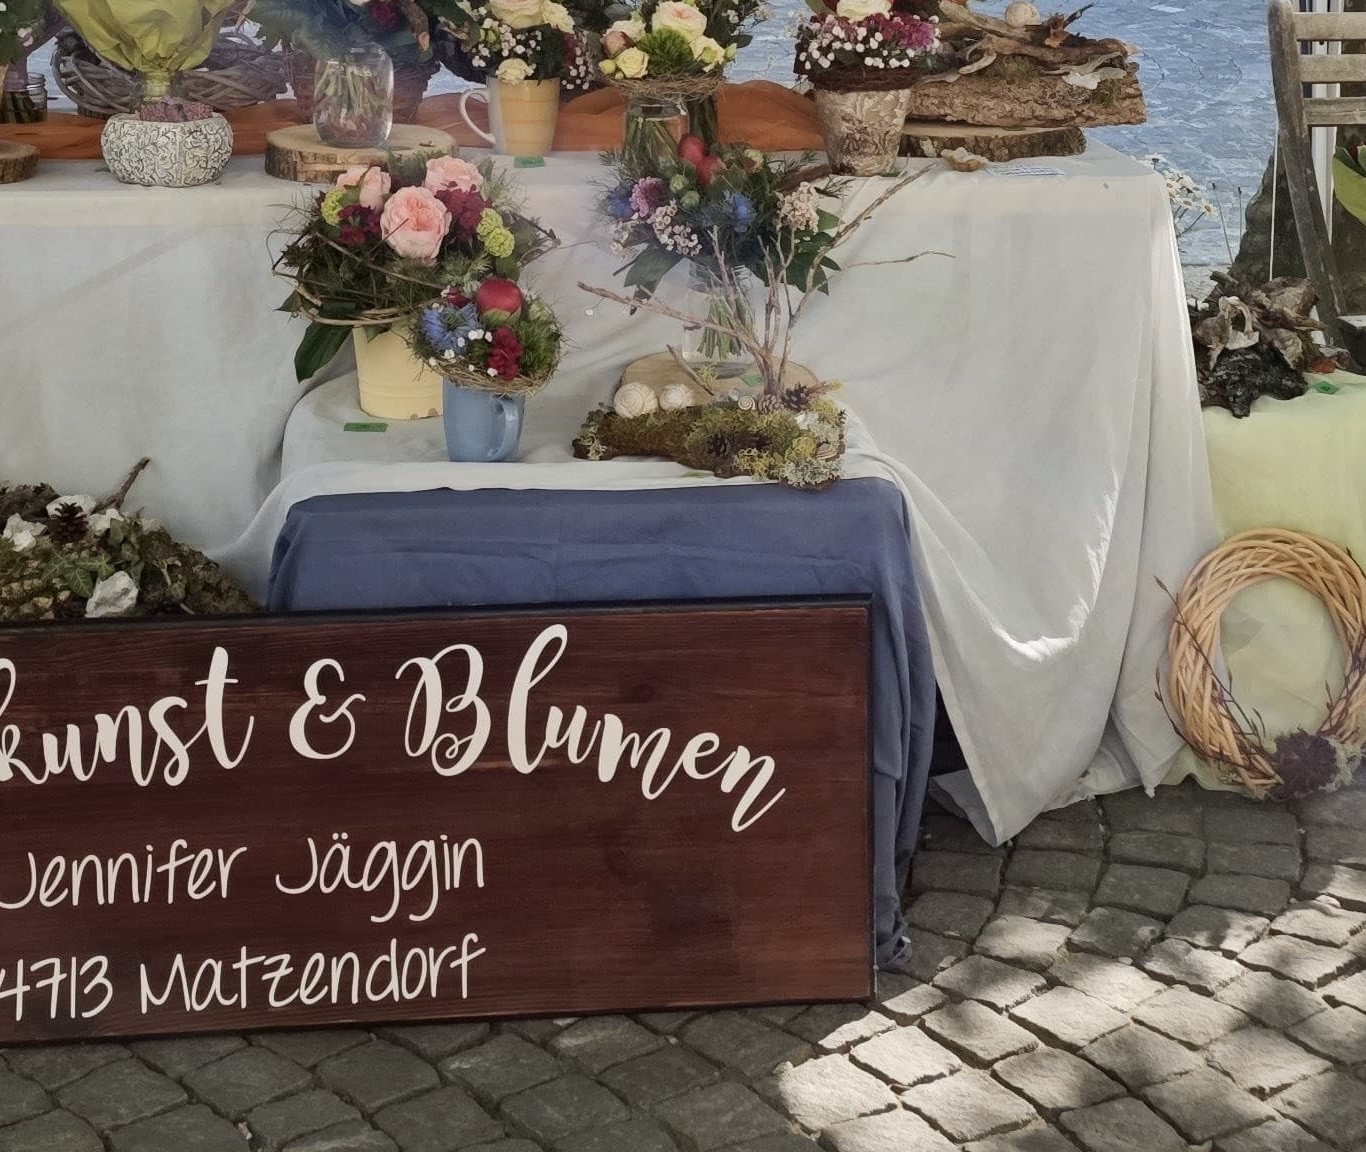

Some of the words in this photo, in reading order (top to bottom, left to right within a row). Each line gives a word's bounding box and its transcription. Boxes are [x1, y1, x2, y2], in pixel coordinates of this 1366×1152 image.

[289, 658, 367, 760] &
[395, 623, 786, 833] Blumen
[275, 834, 485, 923] Jäggin
[139, 931, 487, 1014] Matzendorf
